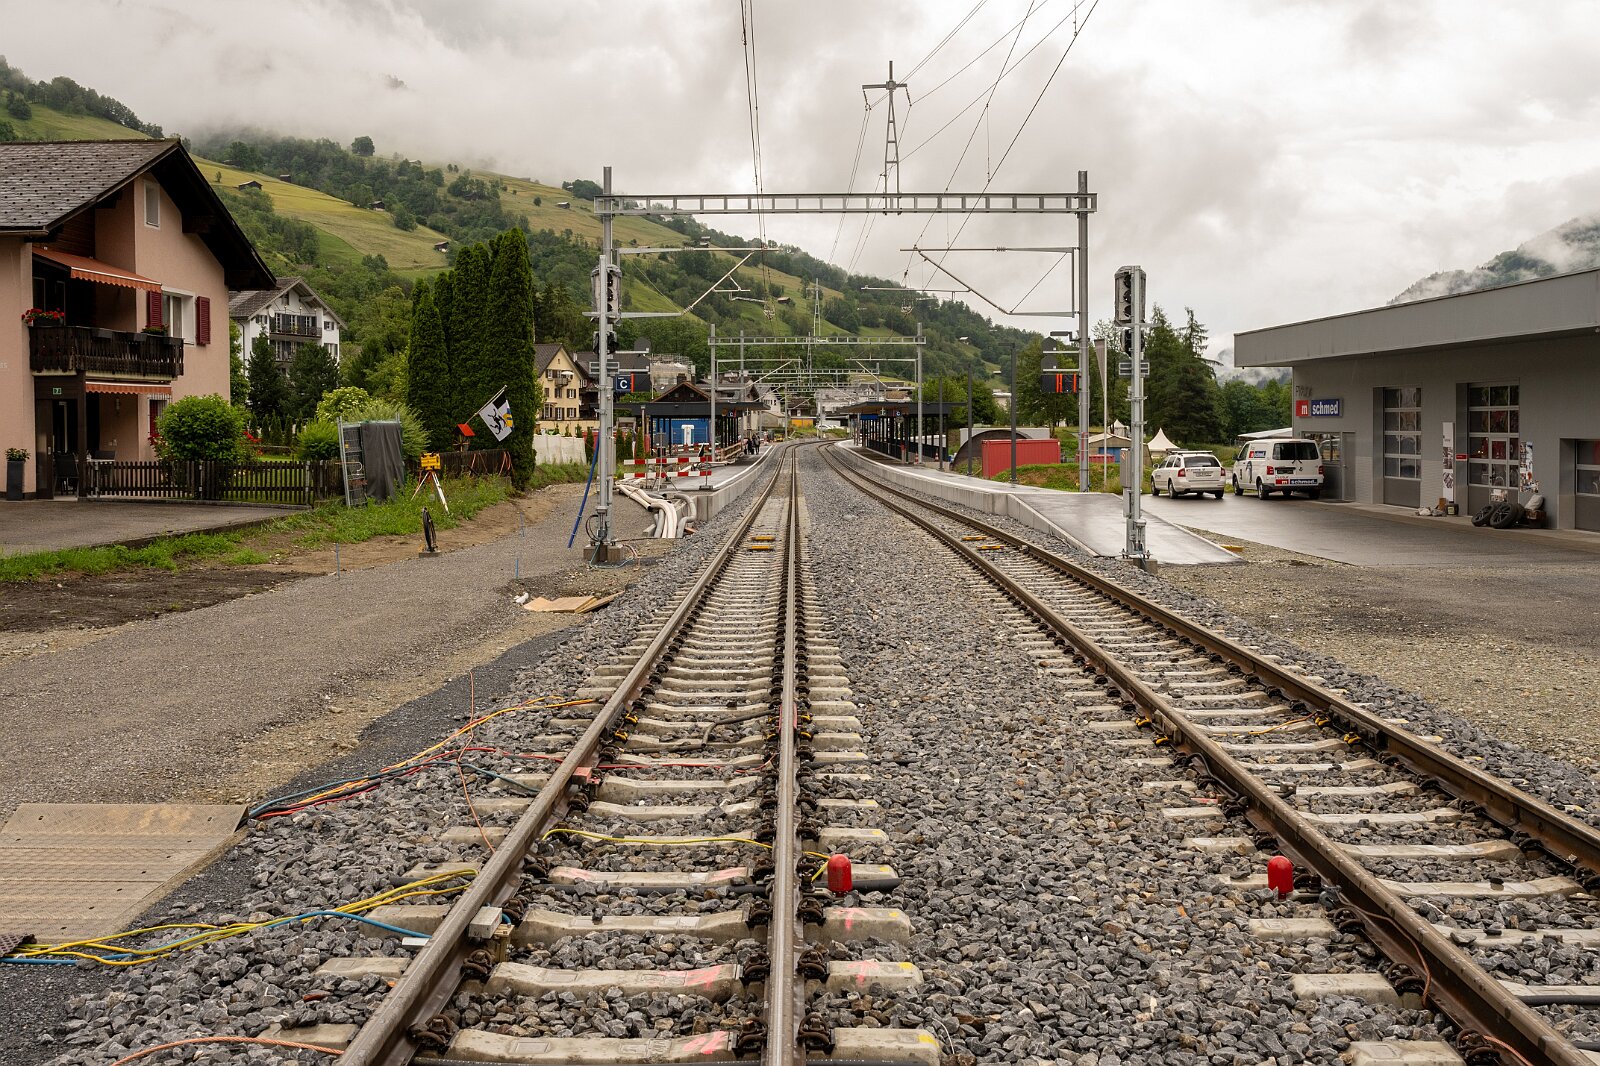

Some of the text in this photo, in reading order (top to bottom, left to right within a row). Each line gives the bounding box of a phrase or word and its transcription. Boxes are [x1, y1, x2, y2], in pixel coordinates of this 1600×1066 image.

[620, 380, 628, 389] C
[1301, 401, 1338, 415] m schmed
